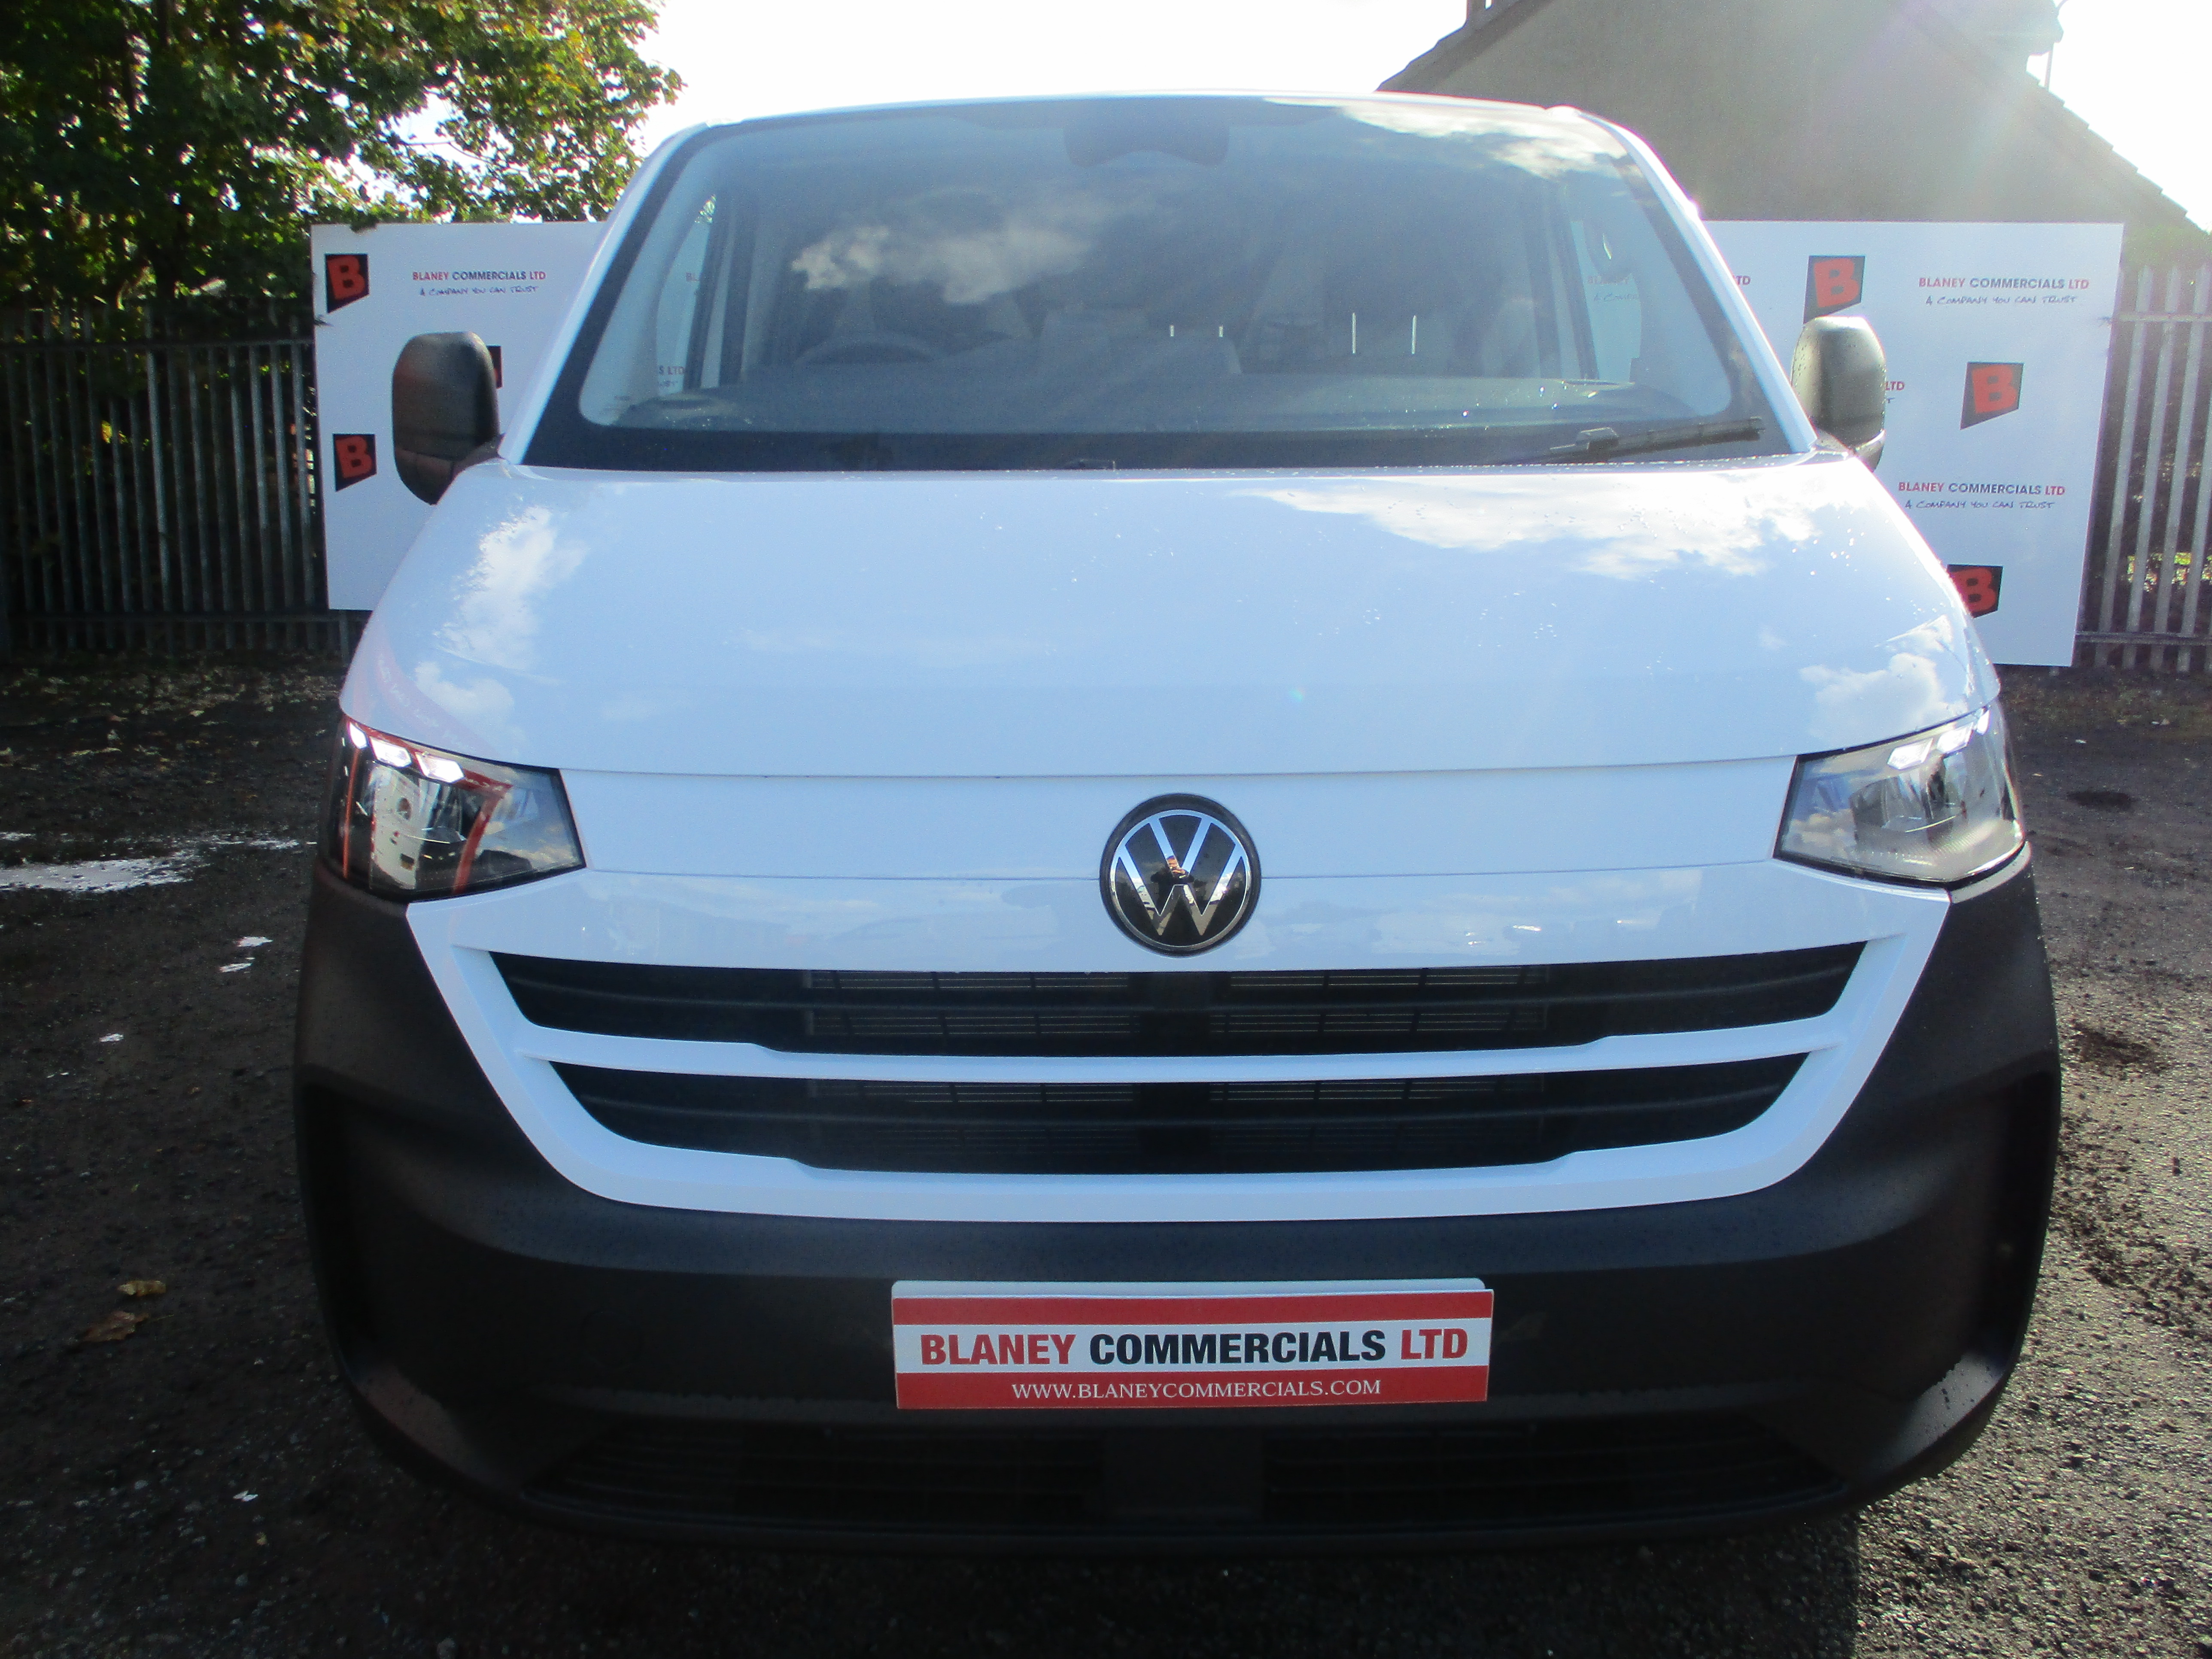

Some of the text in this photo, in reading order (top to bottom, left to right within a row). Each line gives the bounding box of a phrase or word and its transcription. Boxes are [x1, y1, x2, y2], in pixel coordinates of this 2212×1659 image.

[328, 255, 365, 300] B
[413, 271, 547, 280] BLANEY COMMERCIALS LTD
[1735, 275, 1751, 285] TD
[1814, 258, 1860, 308] B
[1919, 277, 2090, 289] BLANEY COMMERCIALS LTD
[1926, 295, 1932, 305] A
[1937, 296, 1988, 304] COMPANY
[2042, 296, 2077, 304] TRUST
[1885, 381, 1905, 390] LTD
[1972, 364, 2018, 414] B
[336, 436, 372, 478] B
[1898, 481, 2065, 495] BLANEY COMMERCIALS LTD
[1905, 500, 1911, 509] A
[1916, 500, 1967, 508] COMPANY
[921, 1328, 1468, 1364] BLANEY COMMERCIALS LTD
[1012, 1379, 1381, 1399] WWW.BLANEYCOMMERCIALS.COM
